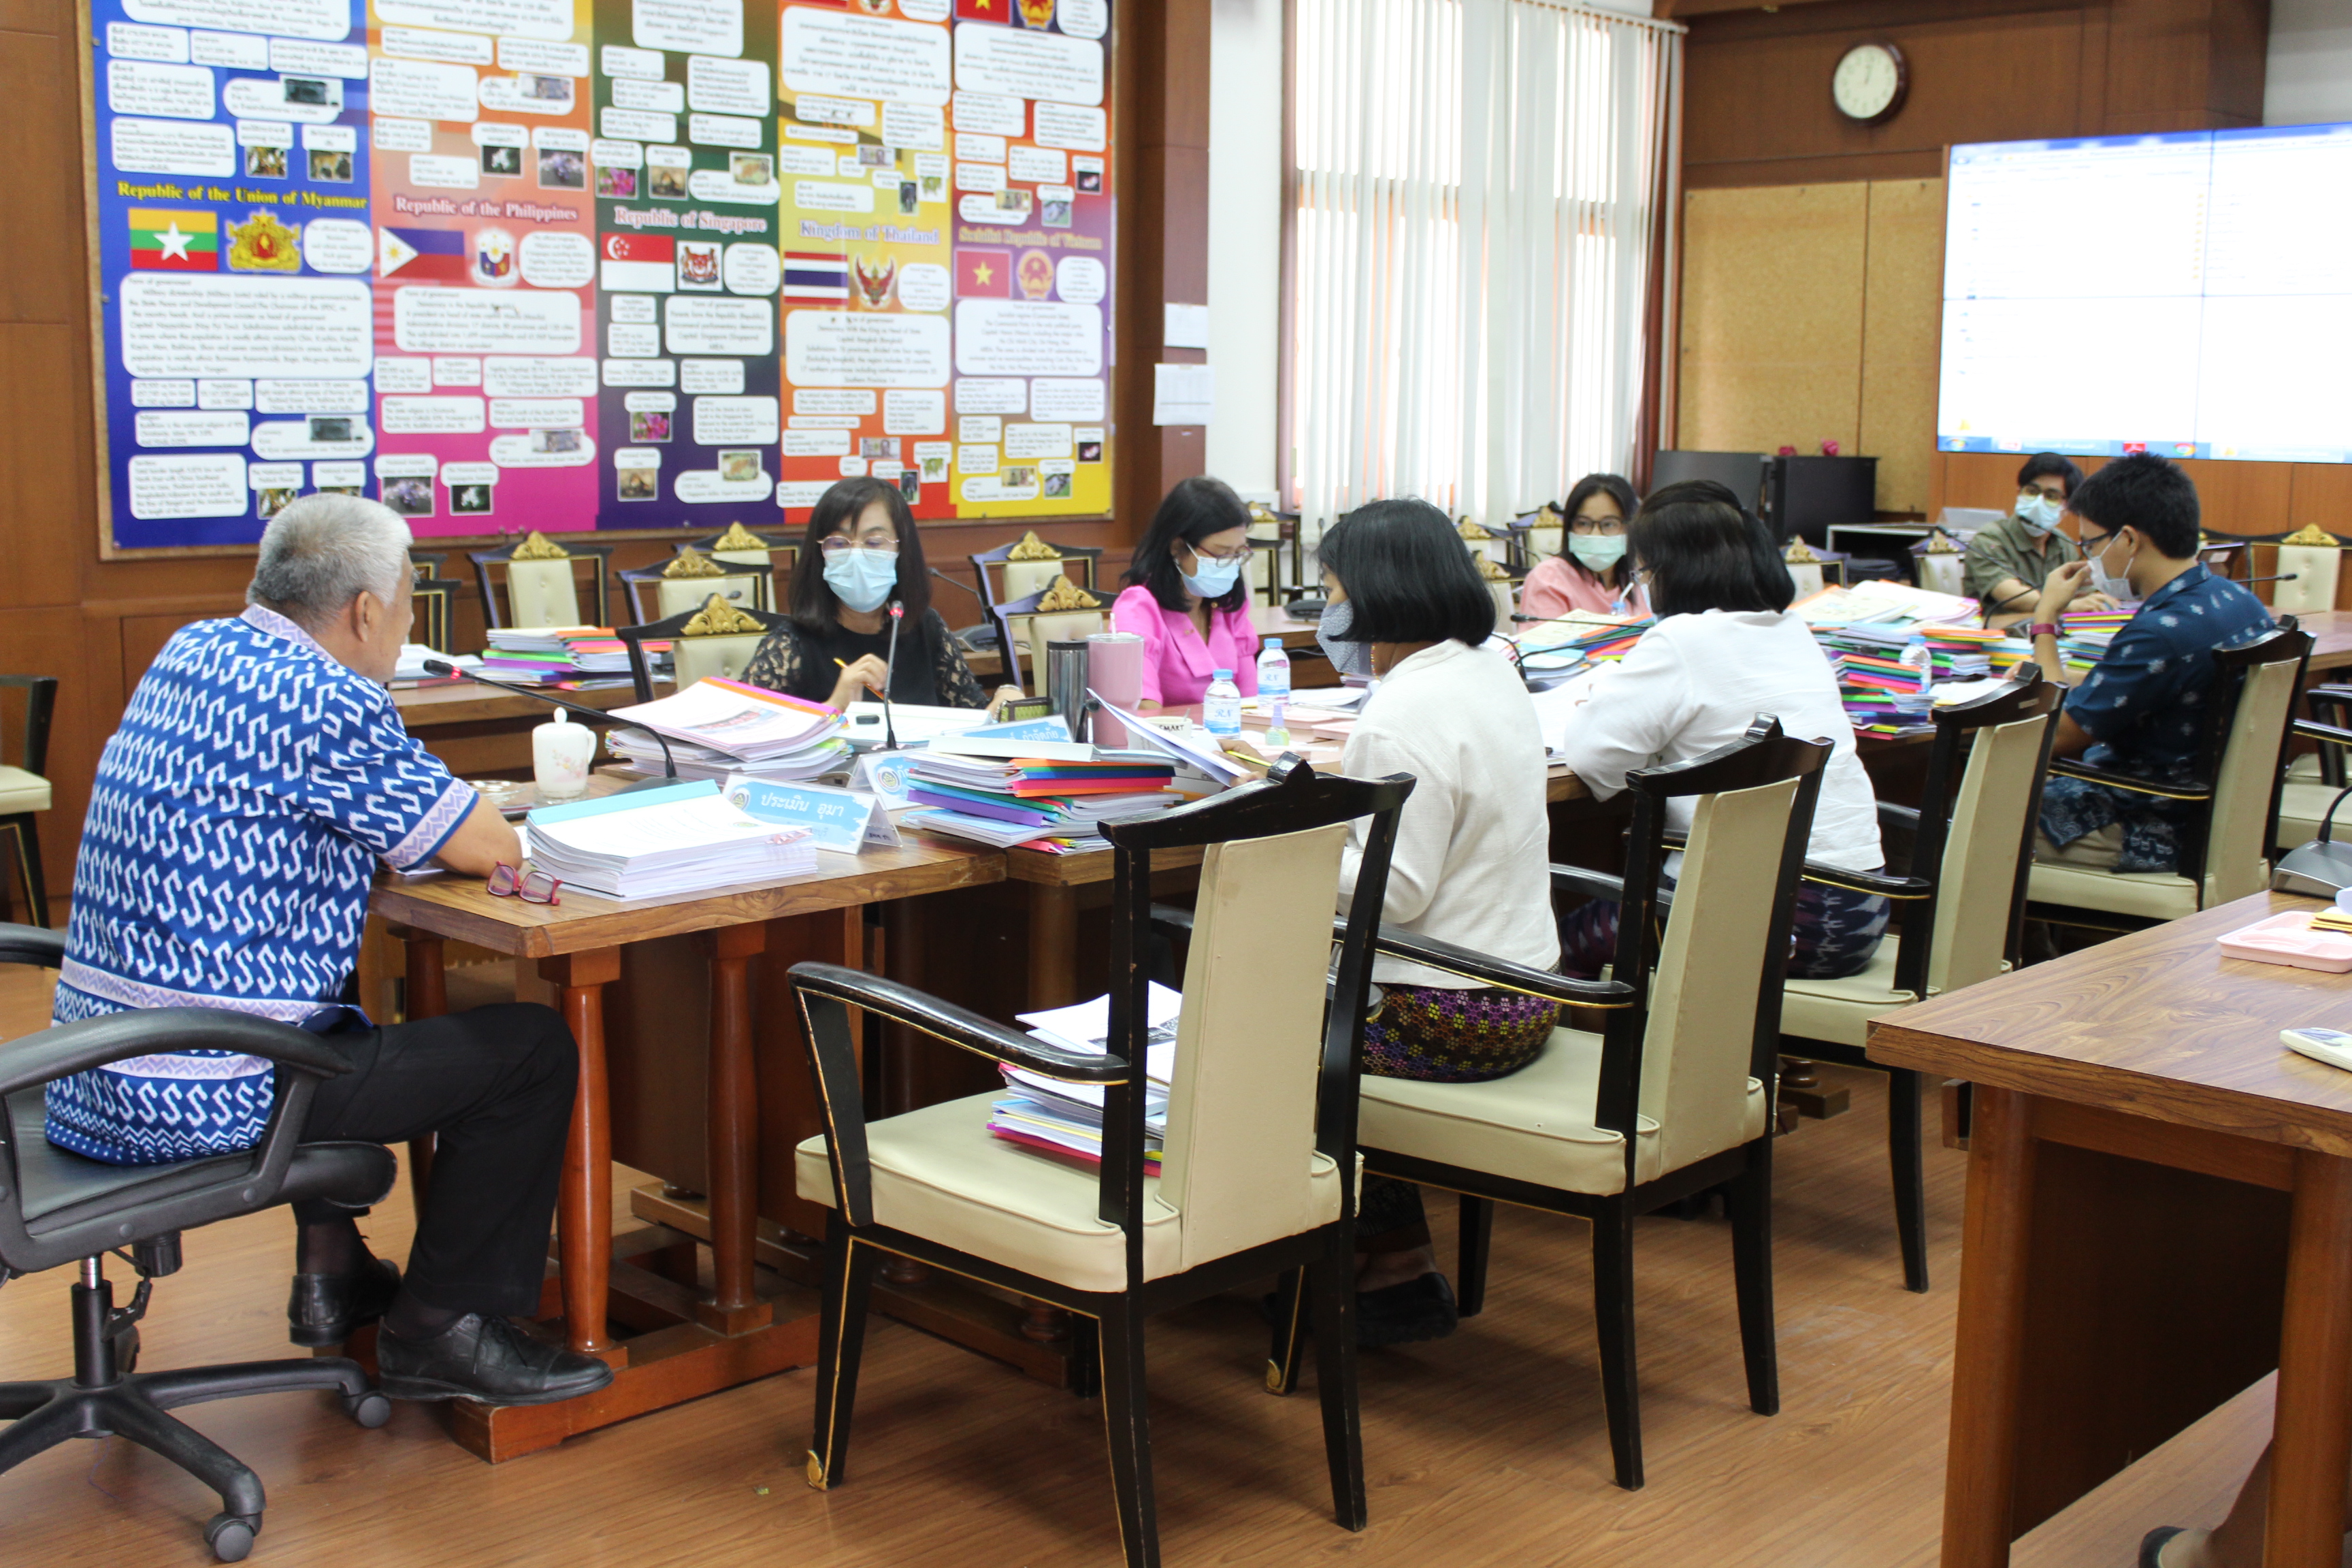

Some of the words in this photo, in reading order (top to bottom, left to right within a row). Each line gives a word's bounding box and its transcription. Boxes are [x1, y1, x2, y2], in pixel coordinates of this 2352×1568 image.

[118, 181, 183, 201] Republic
[188, 186, 204, 200] of
[208, 186, 231, 203] the
[236, 187, 278, 204] Union
[282, 191, 298, 206] of
[301, 192, 368, 210] Myanmar
[395, 197, 457, 216] Republic
[461, 201, 476, 216] of
[480, 201, 501, 217] the
[506, 203, 578, 222] Philippines
[615, 207, 677, 229] Republic
[681, 210, 696, 227] of
[699, 212, 768, 235] Singapore
[800, 220, 861, 243] Kingdom
[864, 224, 880, 242] of
[883, 225, 940, 245] Thailand
[1264, 673, 1279, 682] RN
[1214, 708, 1233, 718] RN
[1159, 724, 1185, 732] SMART
[761, 792, 810, 813] ประเมิน
[817, 802, 845, 820] อุมา
